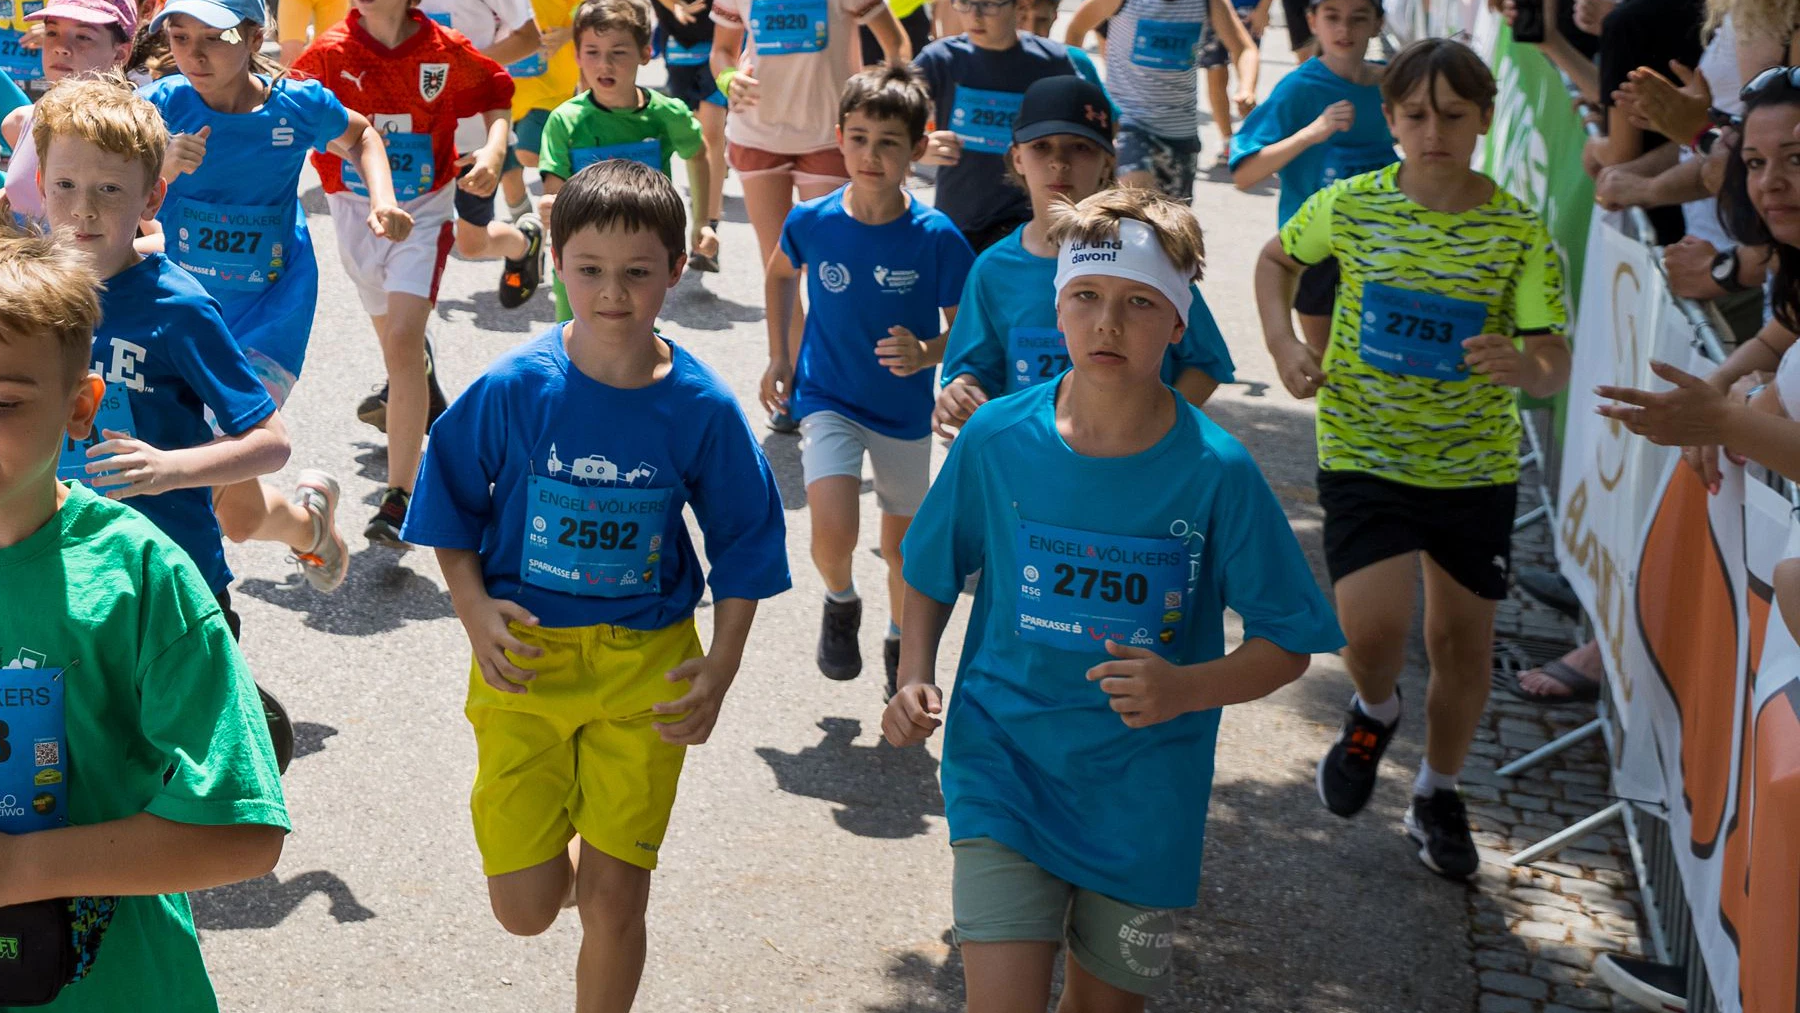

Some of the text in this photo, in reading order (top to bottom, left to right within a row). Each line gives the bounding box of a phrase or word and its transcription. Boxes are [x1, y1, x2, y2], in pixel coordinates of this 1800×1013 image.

[763, 13, 808, 31] 2920
[183, 207, 282, 226] ENGEL&VÖLKERS
[198, 227, 263, 255] 2827
[1092, 239, 1123, 251] und
[1071, 251, 1117, 264] davon!
[1384, 310, 1454, 344] 2753
[539, 488, 666, 514] ENGEL&VÖLKERS
[557, 516, 640, 551] 2592
[1029, 534, 1181, 567] ENGEL&VÖLKERS
[528, 558, 571, 579] SPARKASSE
[1052, 562, 1149, 606] 2750
[1019, 612, 1072, 633] SPARKASSE
[1117, 923, 1156, 949] BEST
